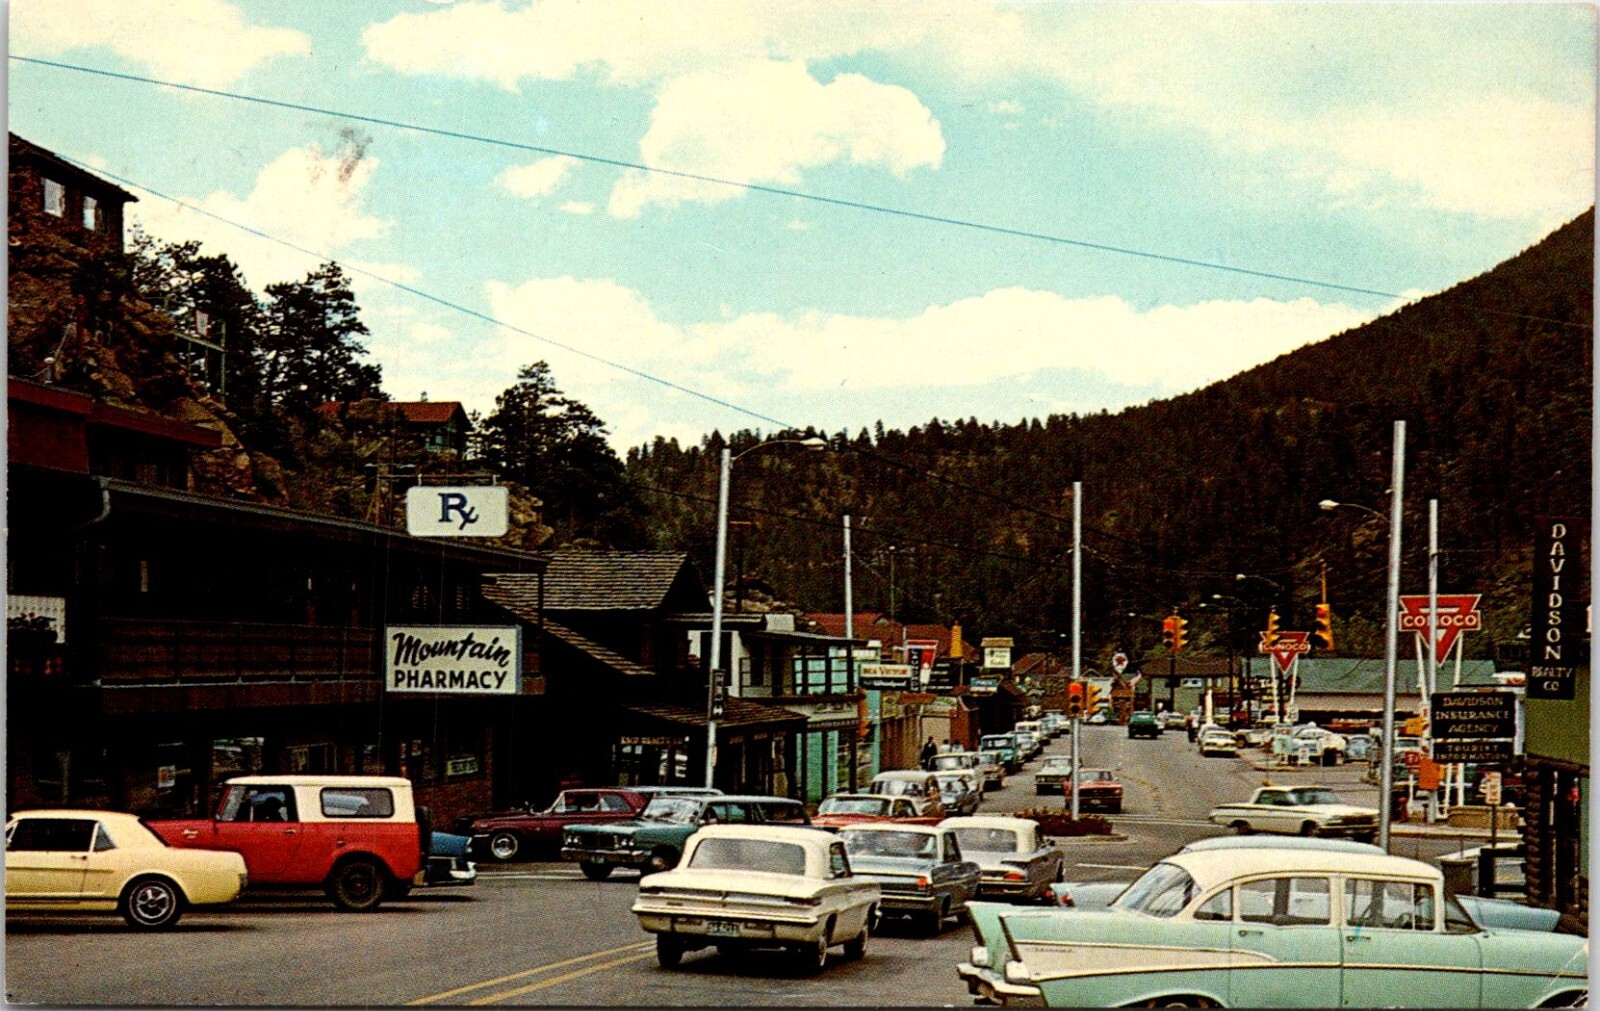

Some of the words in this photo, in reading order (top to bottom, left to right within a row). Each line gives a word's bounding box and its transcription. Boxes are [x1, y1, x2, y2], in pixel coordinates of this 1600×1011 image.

[1544, 523, 1567, 660] DAVIDSON
[392, 632, 512, 668] Mountain
[1531, 666, 1573, 678] REALTY
[394, 670, 508, 689] PHARMACY
[1443, 697, 1503, 706] DAVIDSON
[1435, 710, 1509, 719] INSURANCE
[1448, 724, 1499, 733] AGENCY
